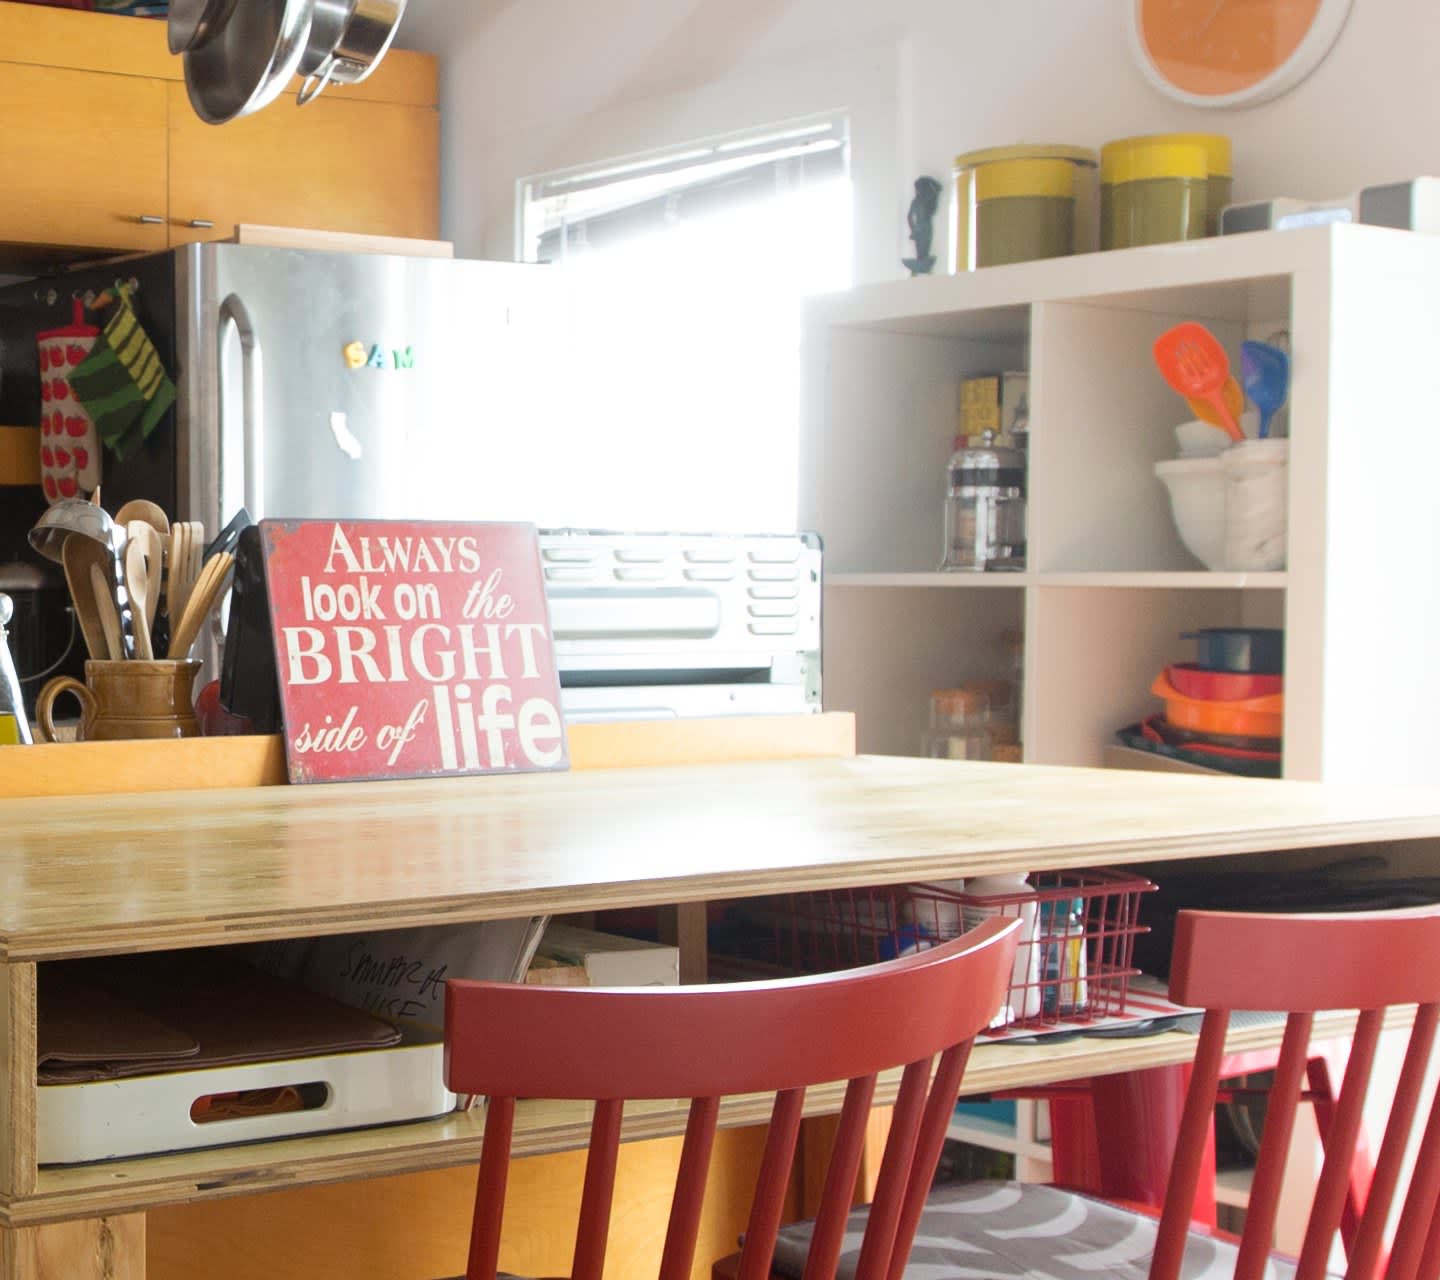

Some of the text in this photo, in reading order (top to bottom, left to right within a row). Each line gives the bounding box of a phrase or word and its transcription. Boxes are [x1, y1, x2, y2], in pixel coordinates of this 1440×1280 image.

[341, 341, 416, 370] SAM
[323, 522, 481, 573] ALWAYS
[301, 568, 516, 621] look on the
[281, 623, 547, 685] BRIGHT
[294, 684, 564, 770] side of life
